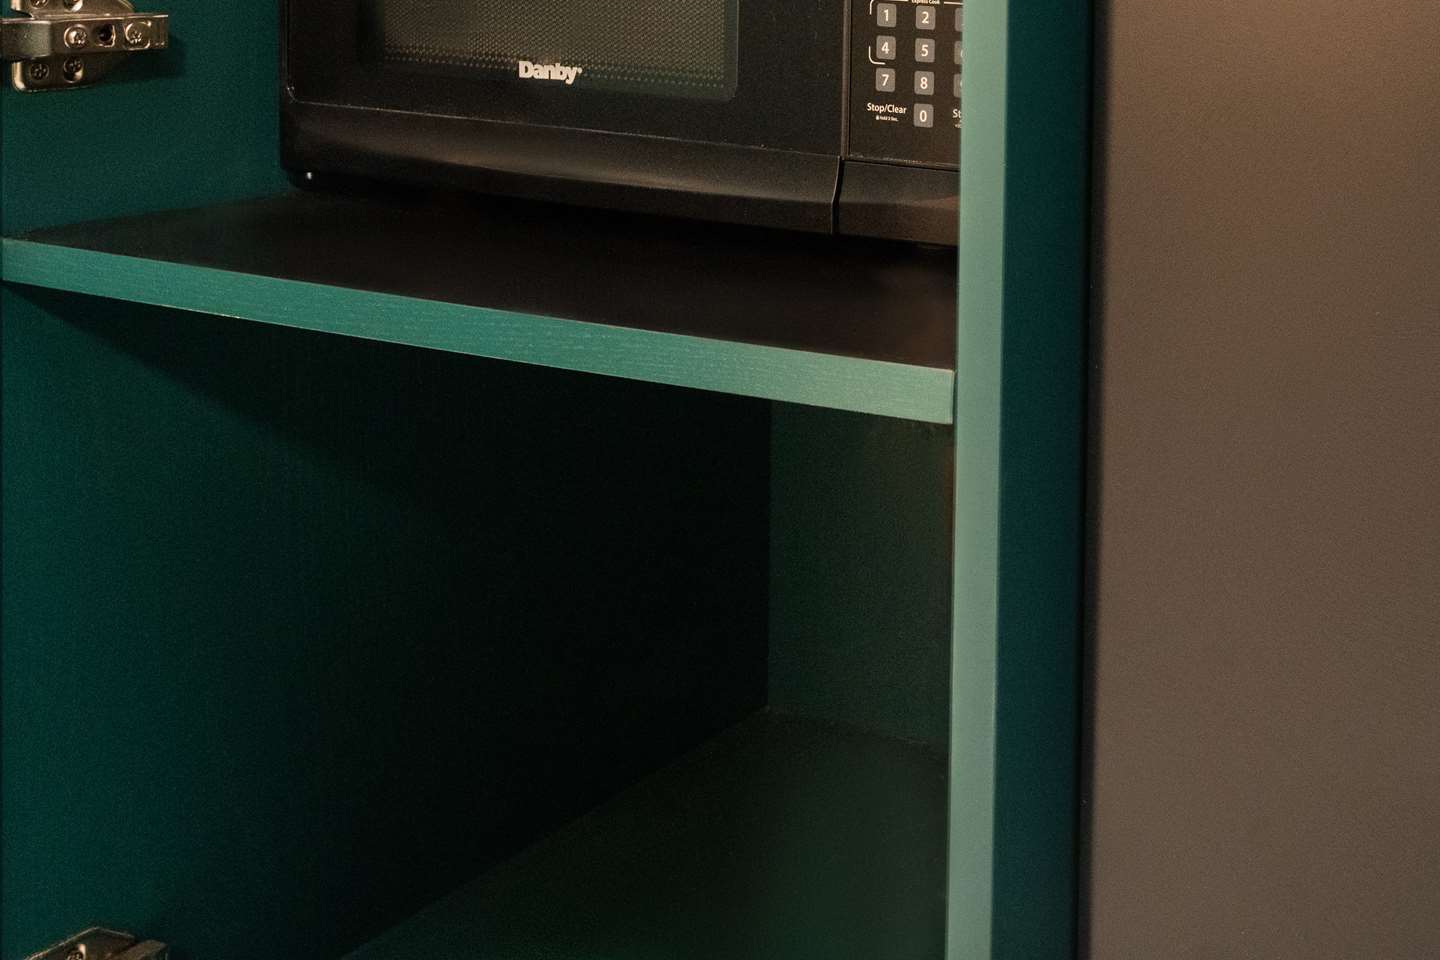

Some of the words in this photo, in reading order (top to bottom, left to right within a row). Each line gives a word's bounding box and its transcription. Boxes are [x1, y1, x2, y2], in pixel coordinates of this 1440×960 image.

[883, 9, 889, 22] 1
[921, 11, 930, 24] 2
[881, 41, 890, 54] 4
[921, 44, 929, 57] 5
[881, 73, 890, 87] 7
[920, 76, 928, 89] 8
[866, 102, 907, 114] Stop/Clear
[920, 110, 928, 123] 0
